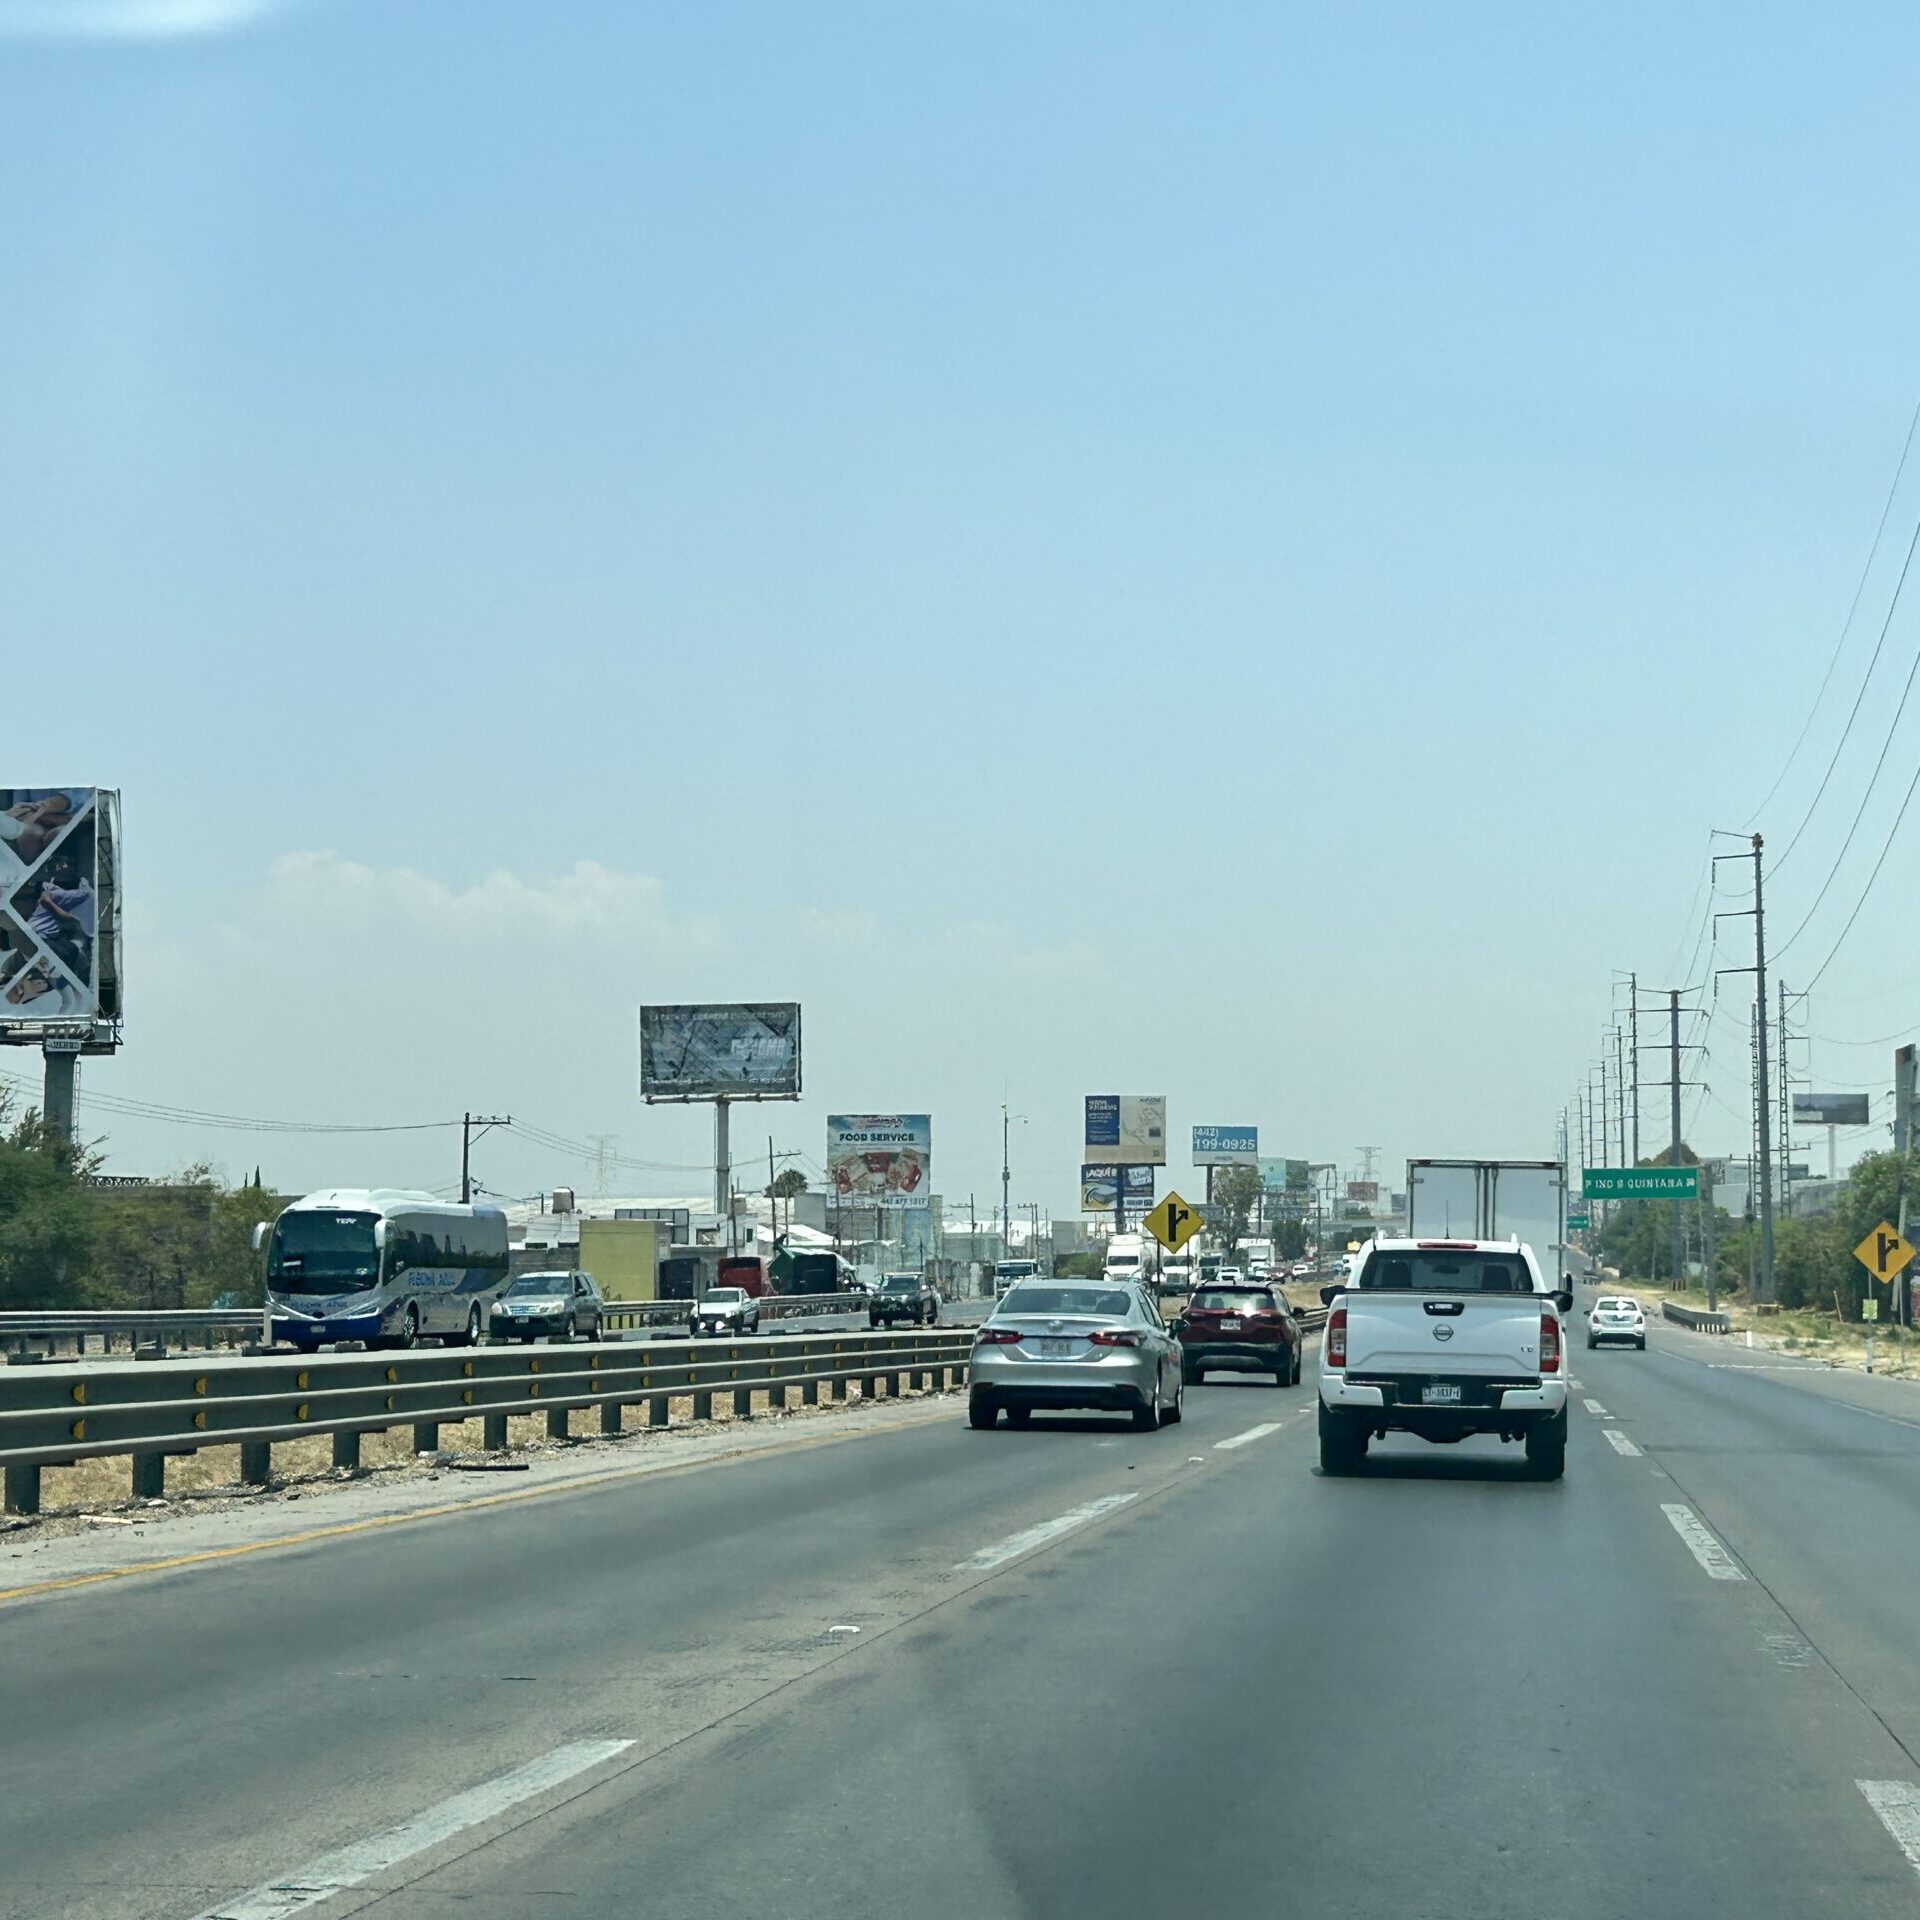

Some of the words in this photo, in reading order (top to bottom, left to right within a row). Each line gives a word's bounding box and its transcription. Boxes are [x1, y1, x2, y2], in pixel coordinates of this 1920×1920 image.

[839, 1133, 867, 1141] FOOD
[870, 1133, 915, 1141] SERVICE
[1194, 1138, 1256, 1150] 199-0925
[1627, 1178, 1683, 1189] QUINTANA
